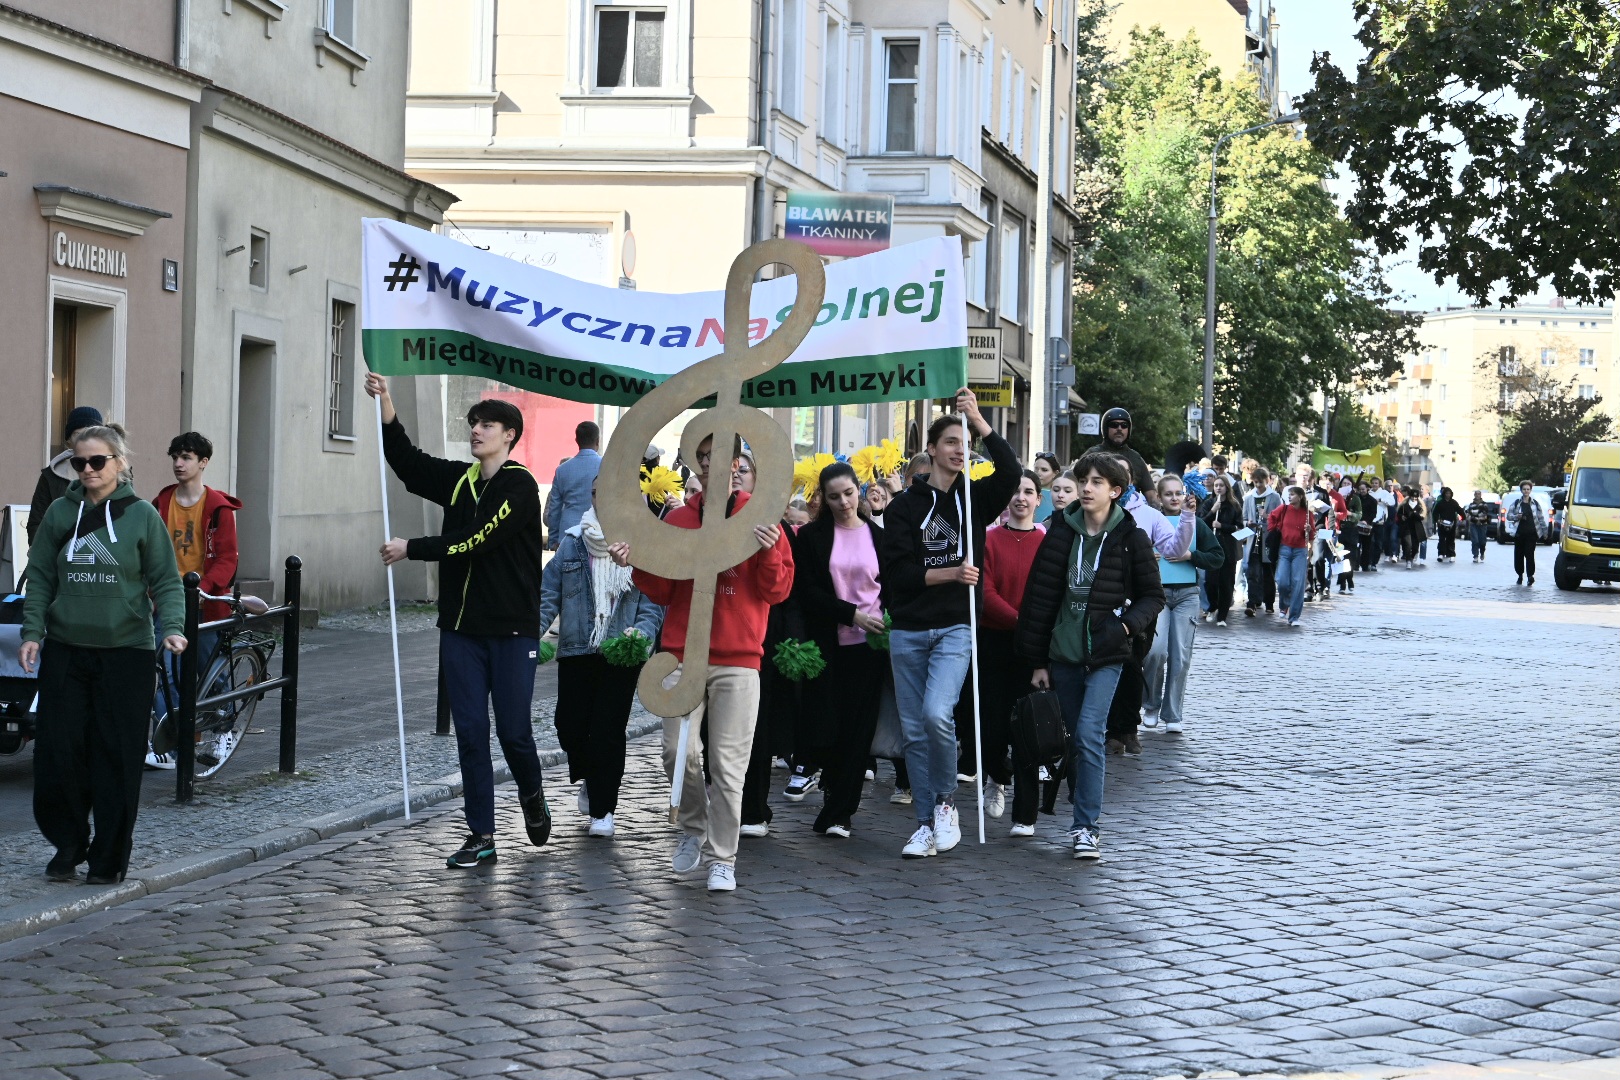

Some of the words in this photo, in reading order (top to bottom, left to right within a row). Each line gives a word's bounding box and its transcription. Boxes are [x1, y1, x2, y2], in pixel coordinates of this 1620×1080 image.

[788, 206, 889, 225] BŁAWATEK
[799, 225, 877, 240] TKANINY
[55, 231, 128, 278] CUKIERNIA
[810, 362, 926, 395] Muzyki
[447, 500, 512, 555] Dickies
[67, 572, 97, 583] POSM
